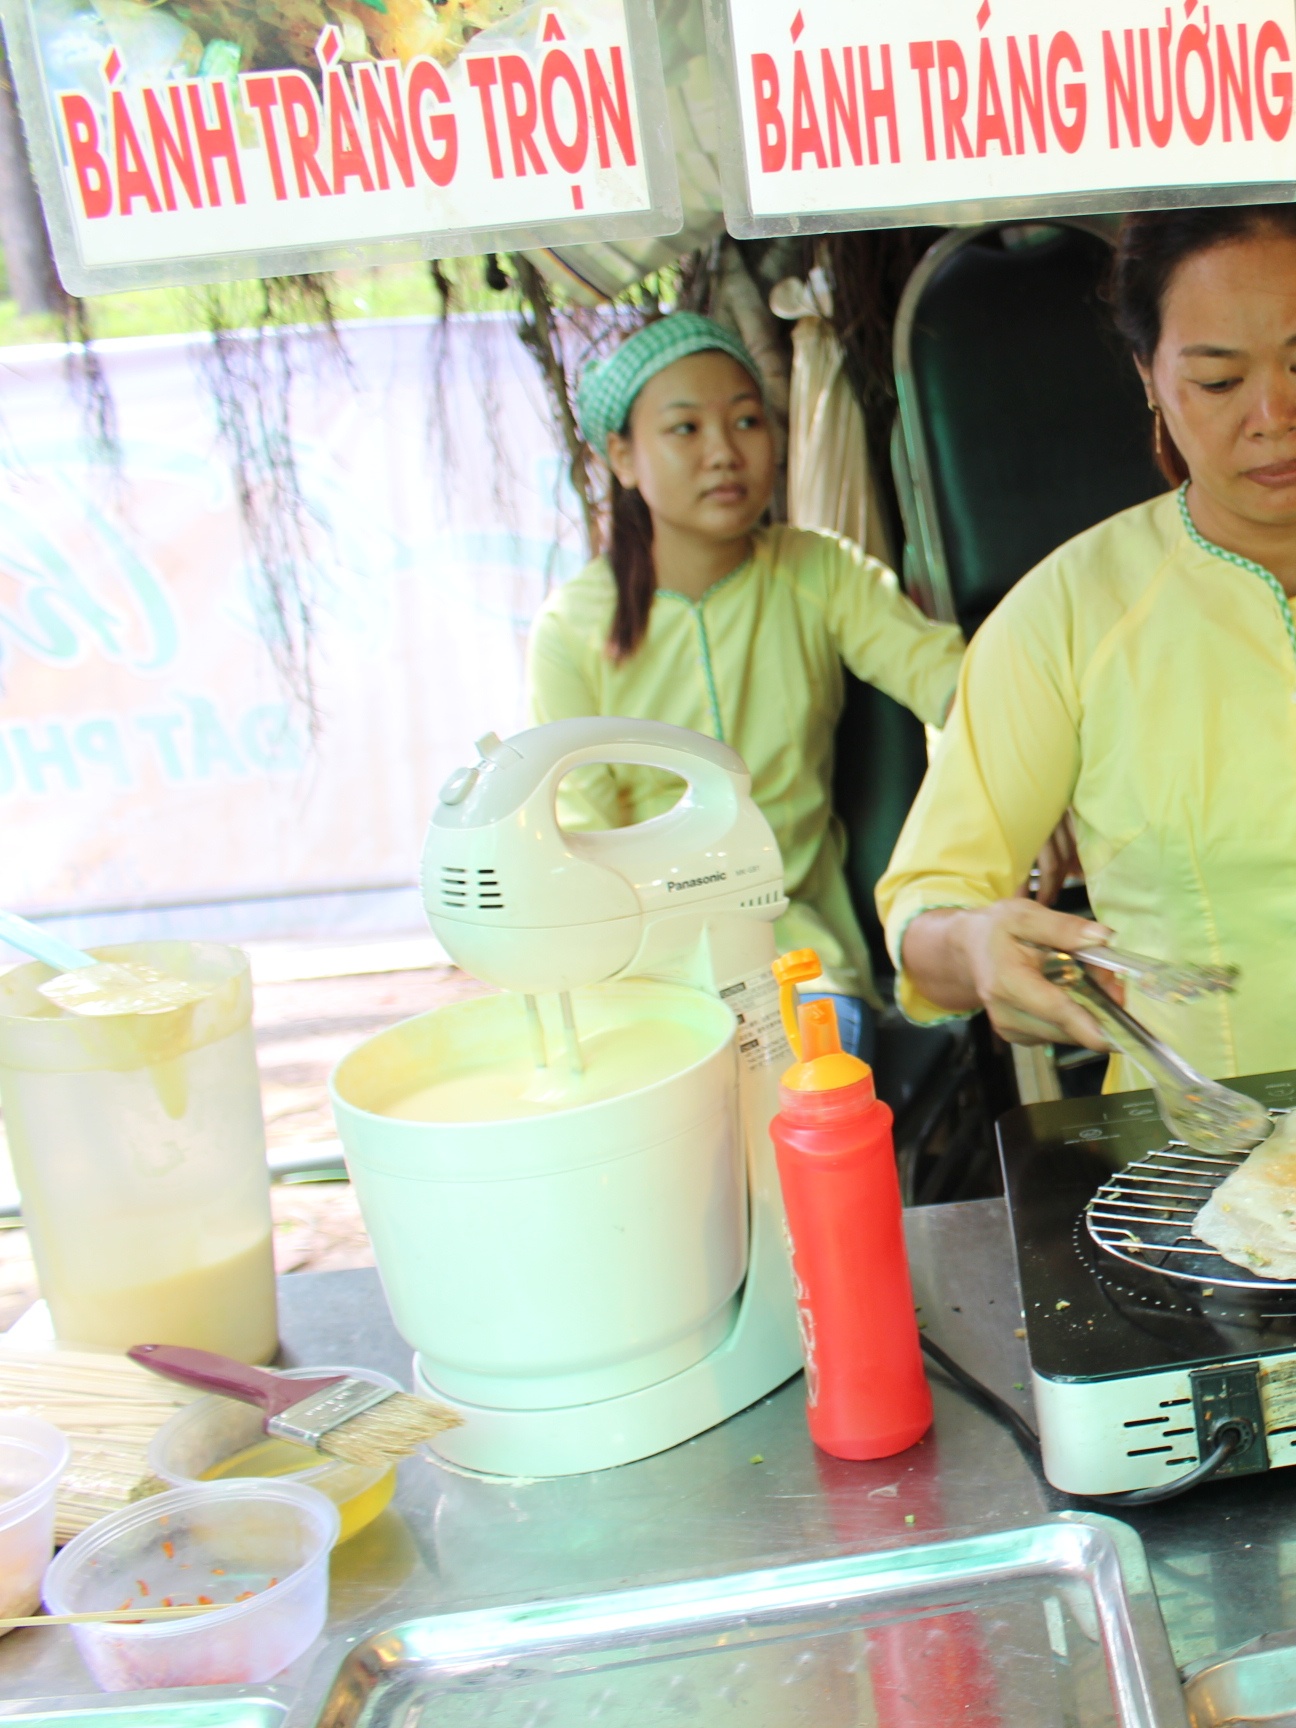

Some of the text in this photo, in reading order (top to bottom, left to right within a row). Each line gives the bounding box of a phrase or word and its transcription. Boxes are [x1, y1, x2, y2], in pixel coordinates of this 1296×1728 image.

[61, 13, 637, 219] BÁNH TRÁNG TRỘN
[751, 0, 1294, 173] BÁNH TRÁNG NƯỚNG
[666, 870, 727, 893] Panasonic
